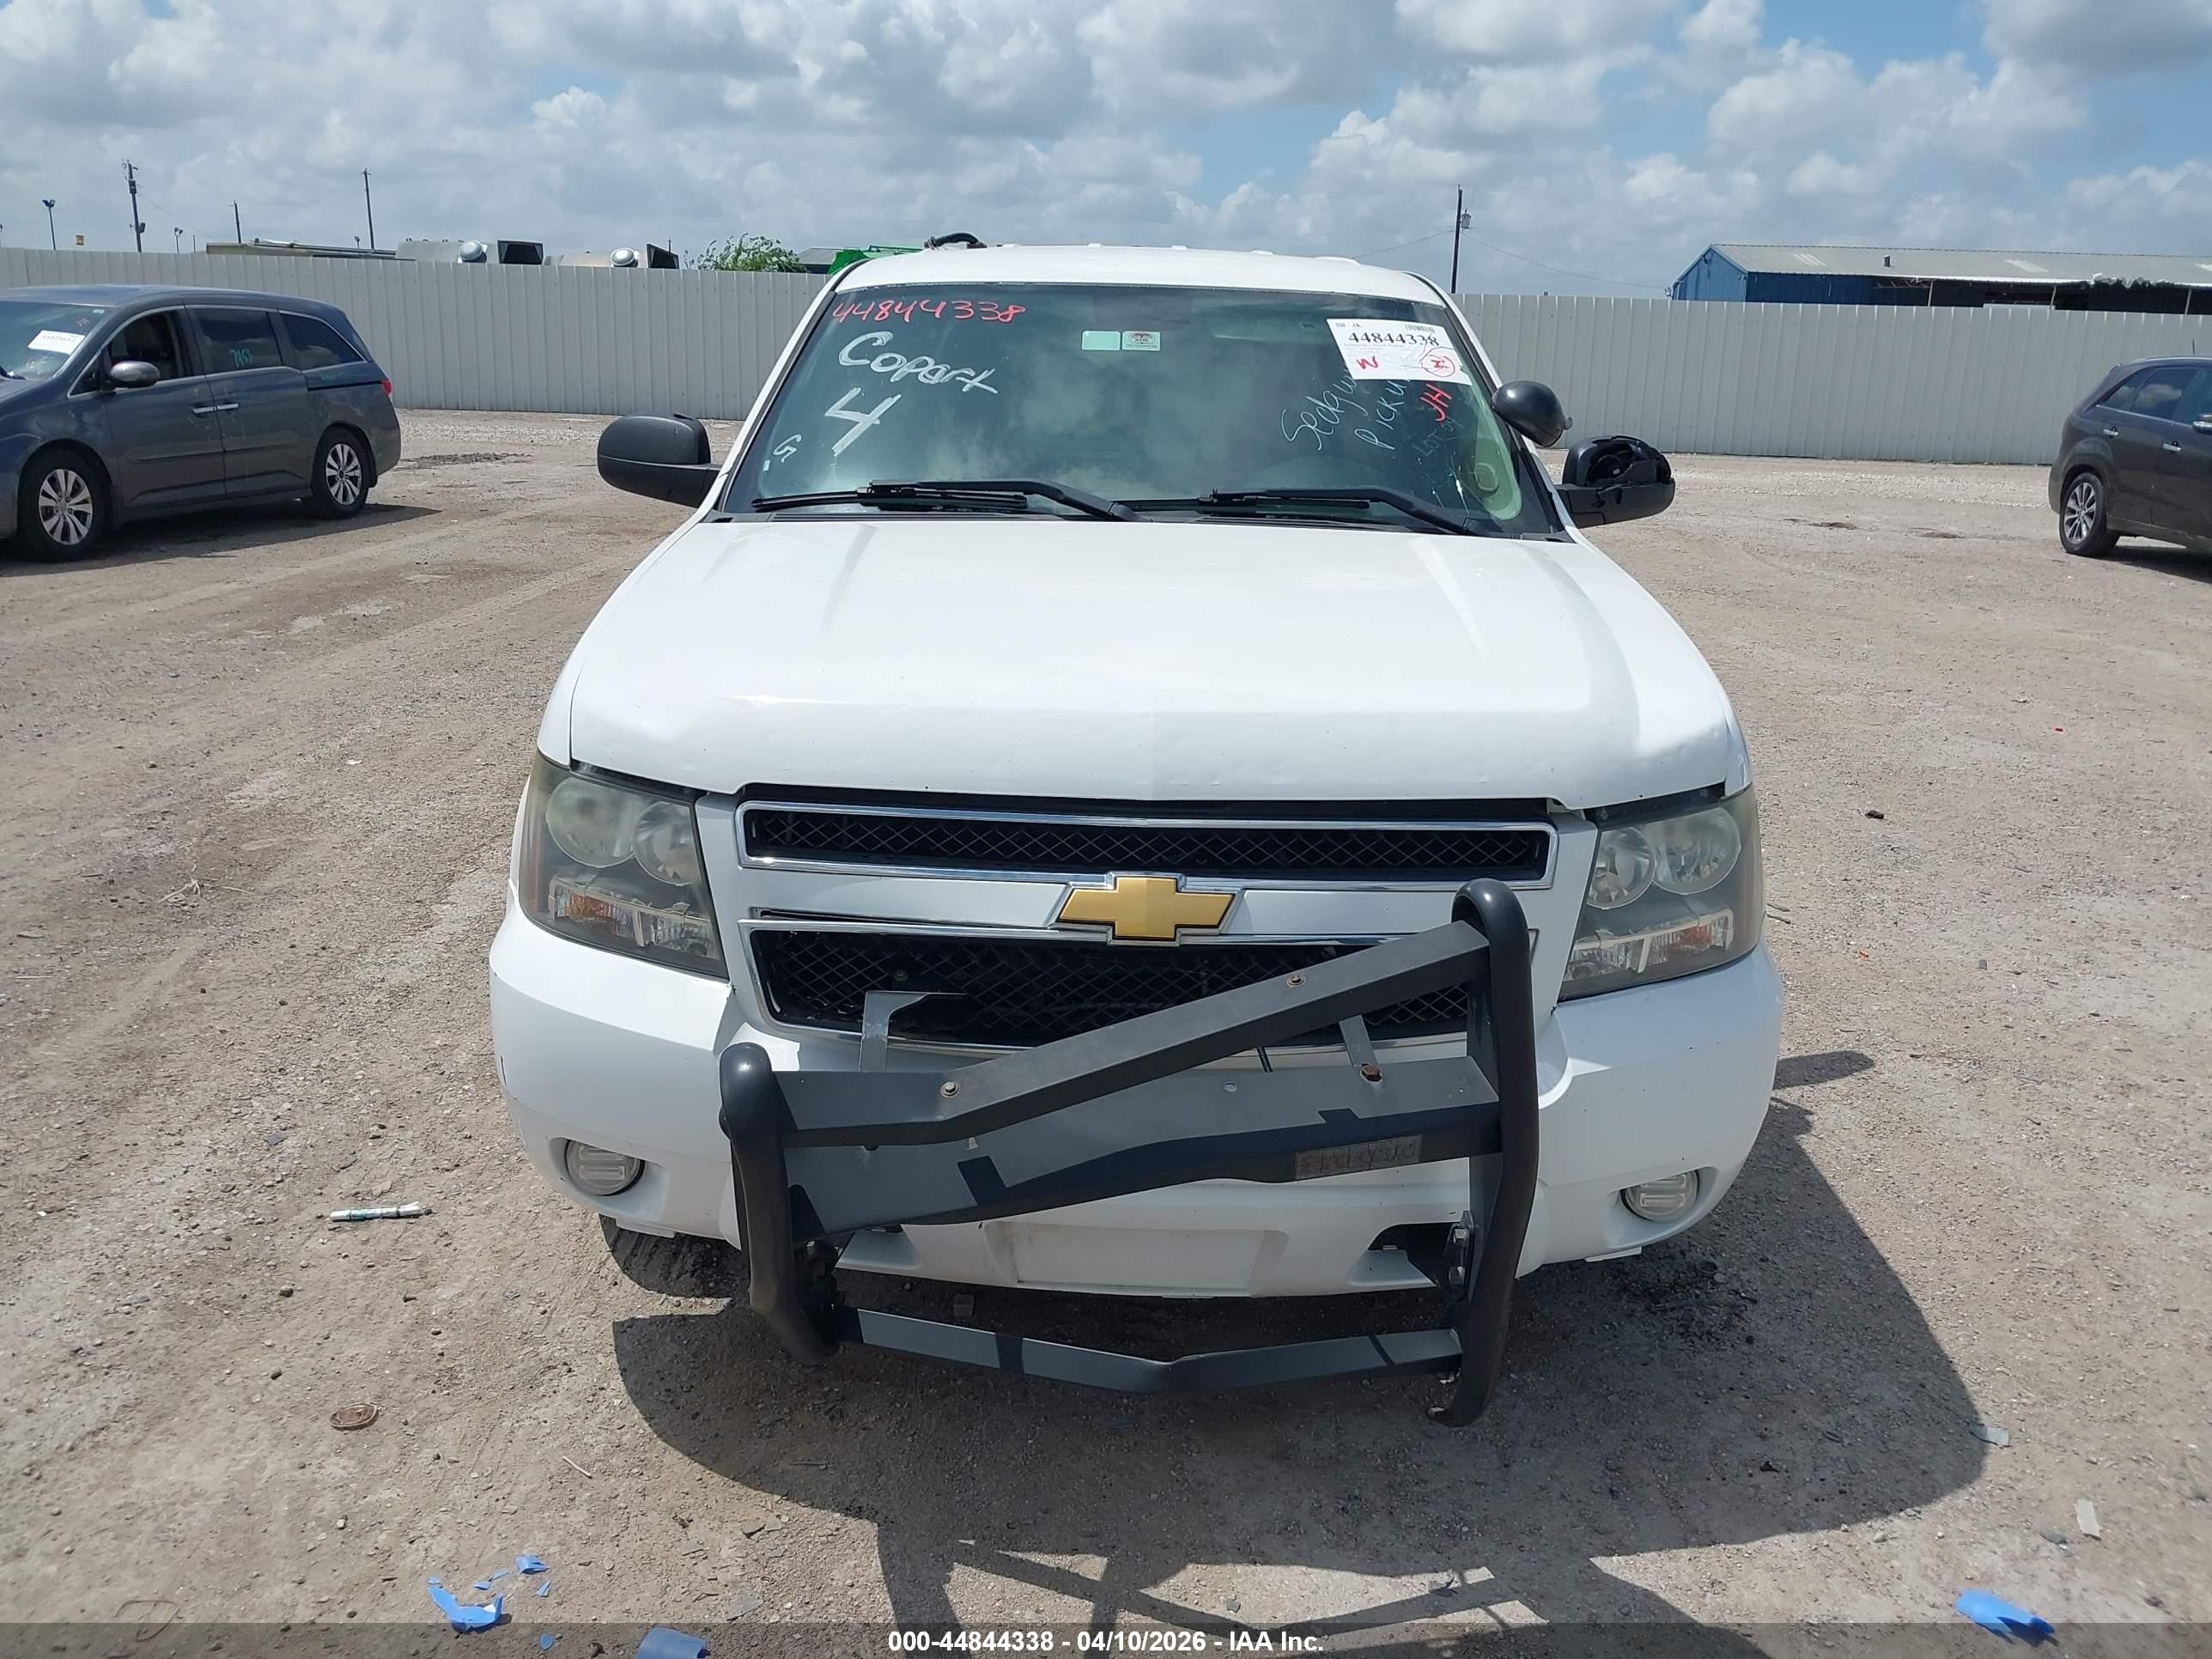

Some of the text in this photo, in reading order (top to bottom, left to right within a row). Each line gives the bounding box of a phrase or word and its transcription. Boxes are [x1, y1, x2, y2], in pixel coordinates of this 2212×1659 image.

[833, 299, 1026, 324] 44844338
[1348, 332, 1440, 347] 44844338
[838, 331, 999, 395] Copart
[824, 387, 902, 457] 4
